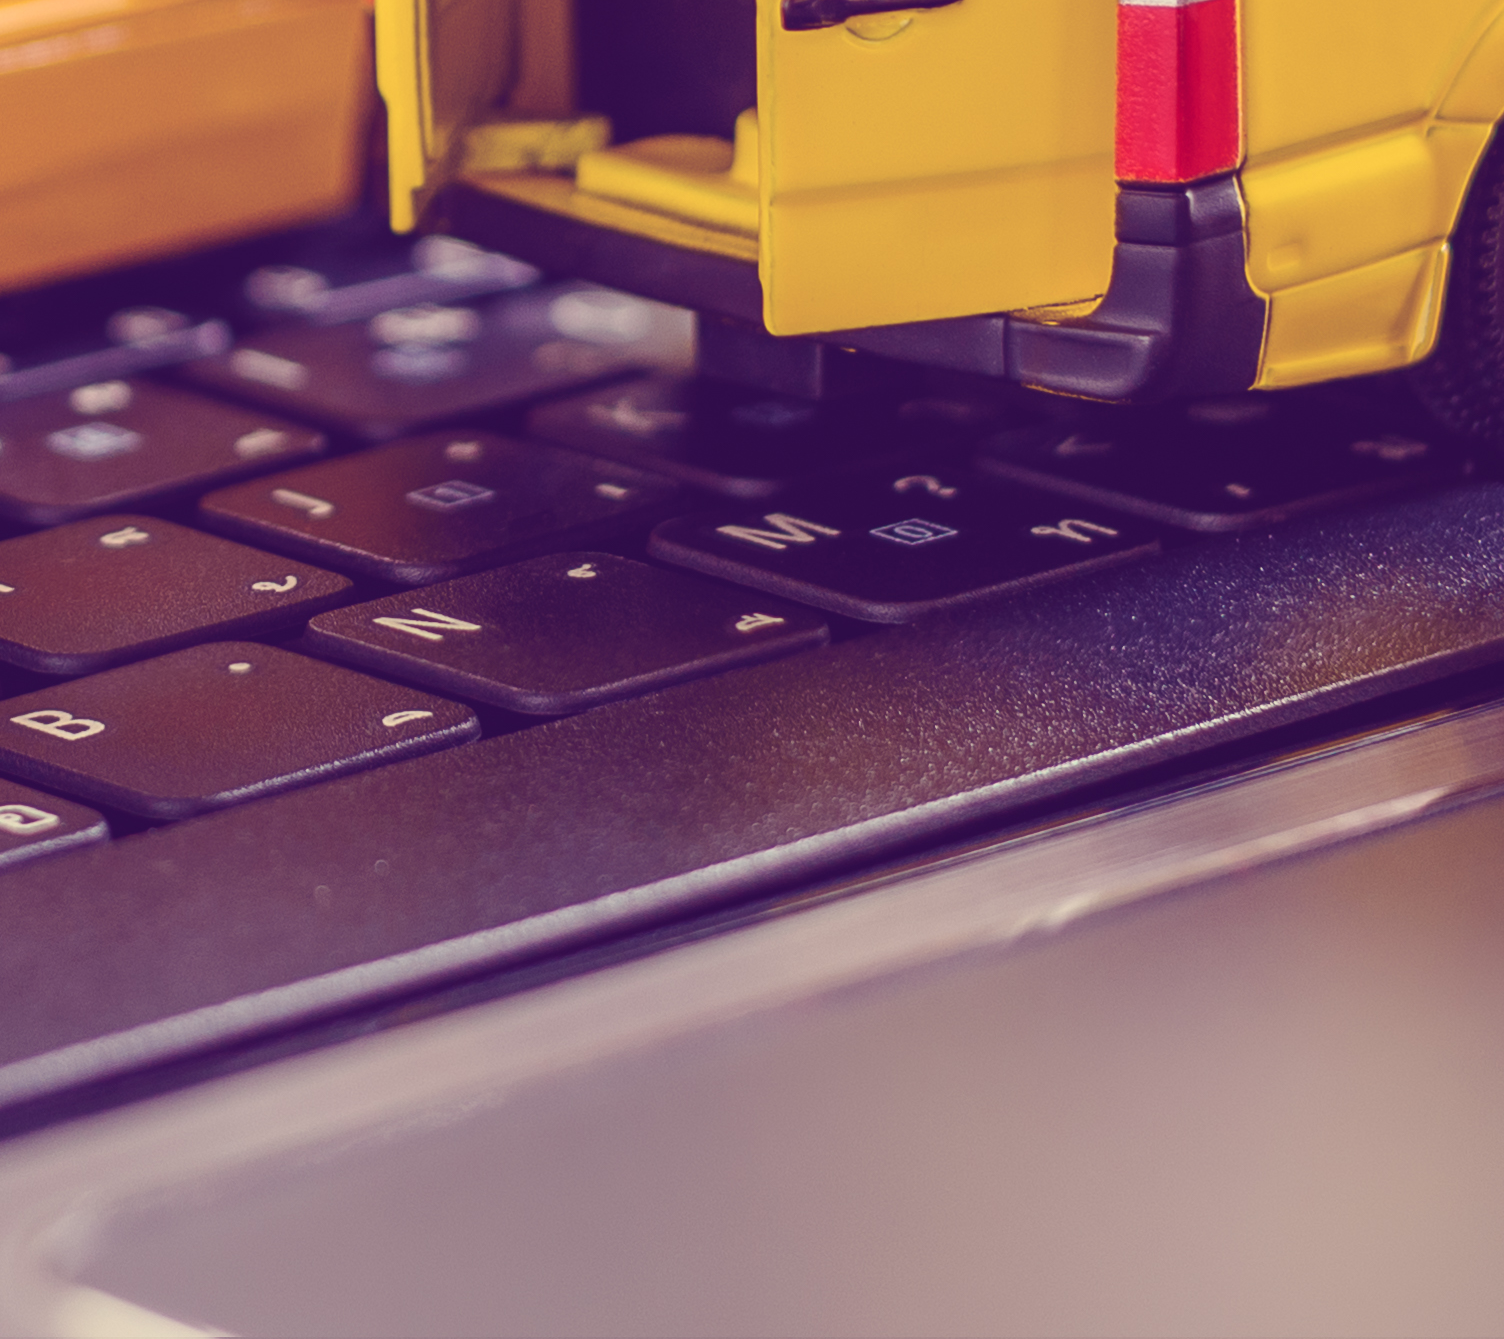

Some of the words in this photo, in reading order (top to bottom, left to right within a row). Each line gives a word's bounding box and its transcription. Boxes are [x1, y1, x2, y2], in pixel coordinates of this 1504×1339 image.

[716, 512, 841, 549] M
[372, 607, 482, 641] N
[8, 709, 106, 742] B
